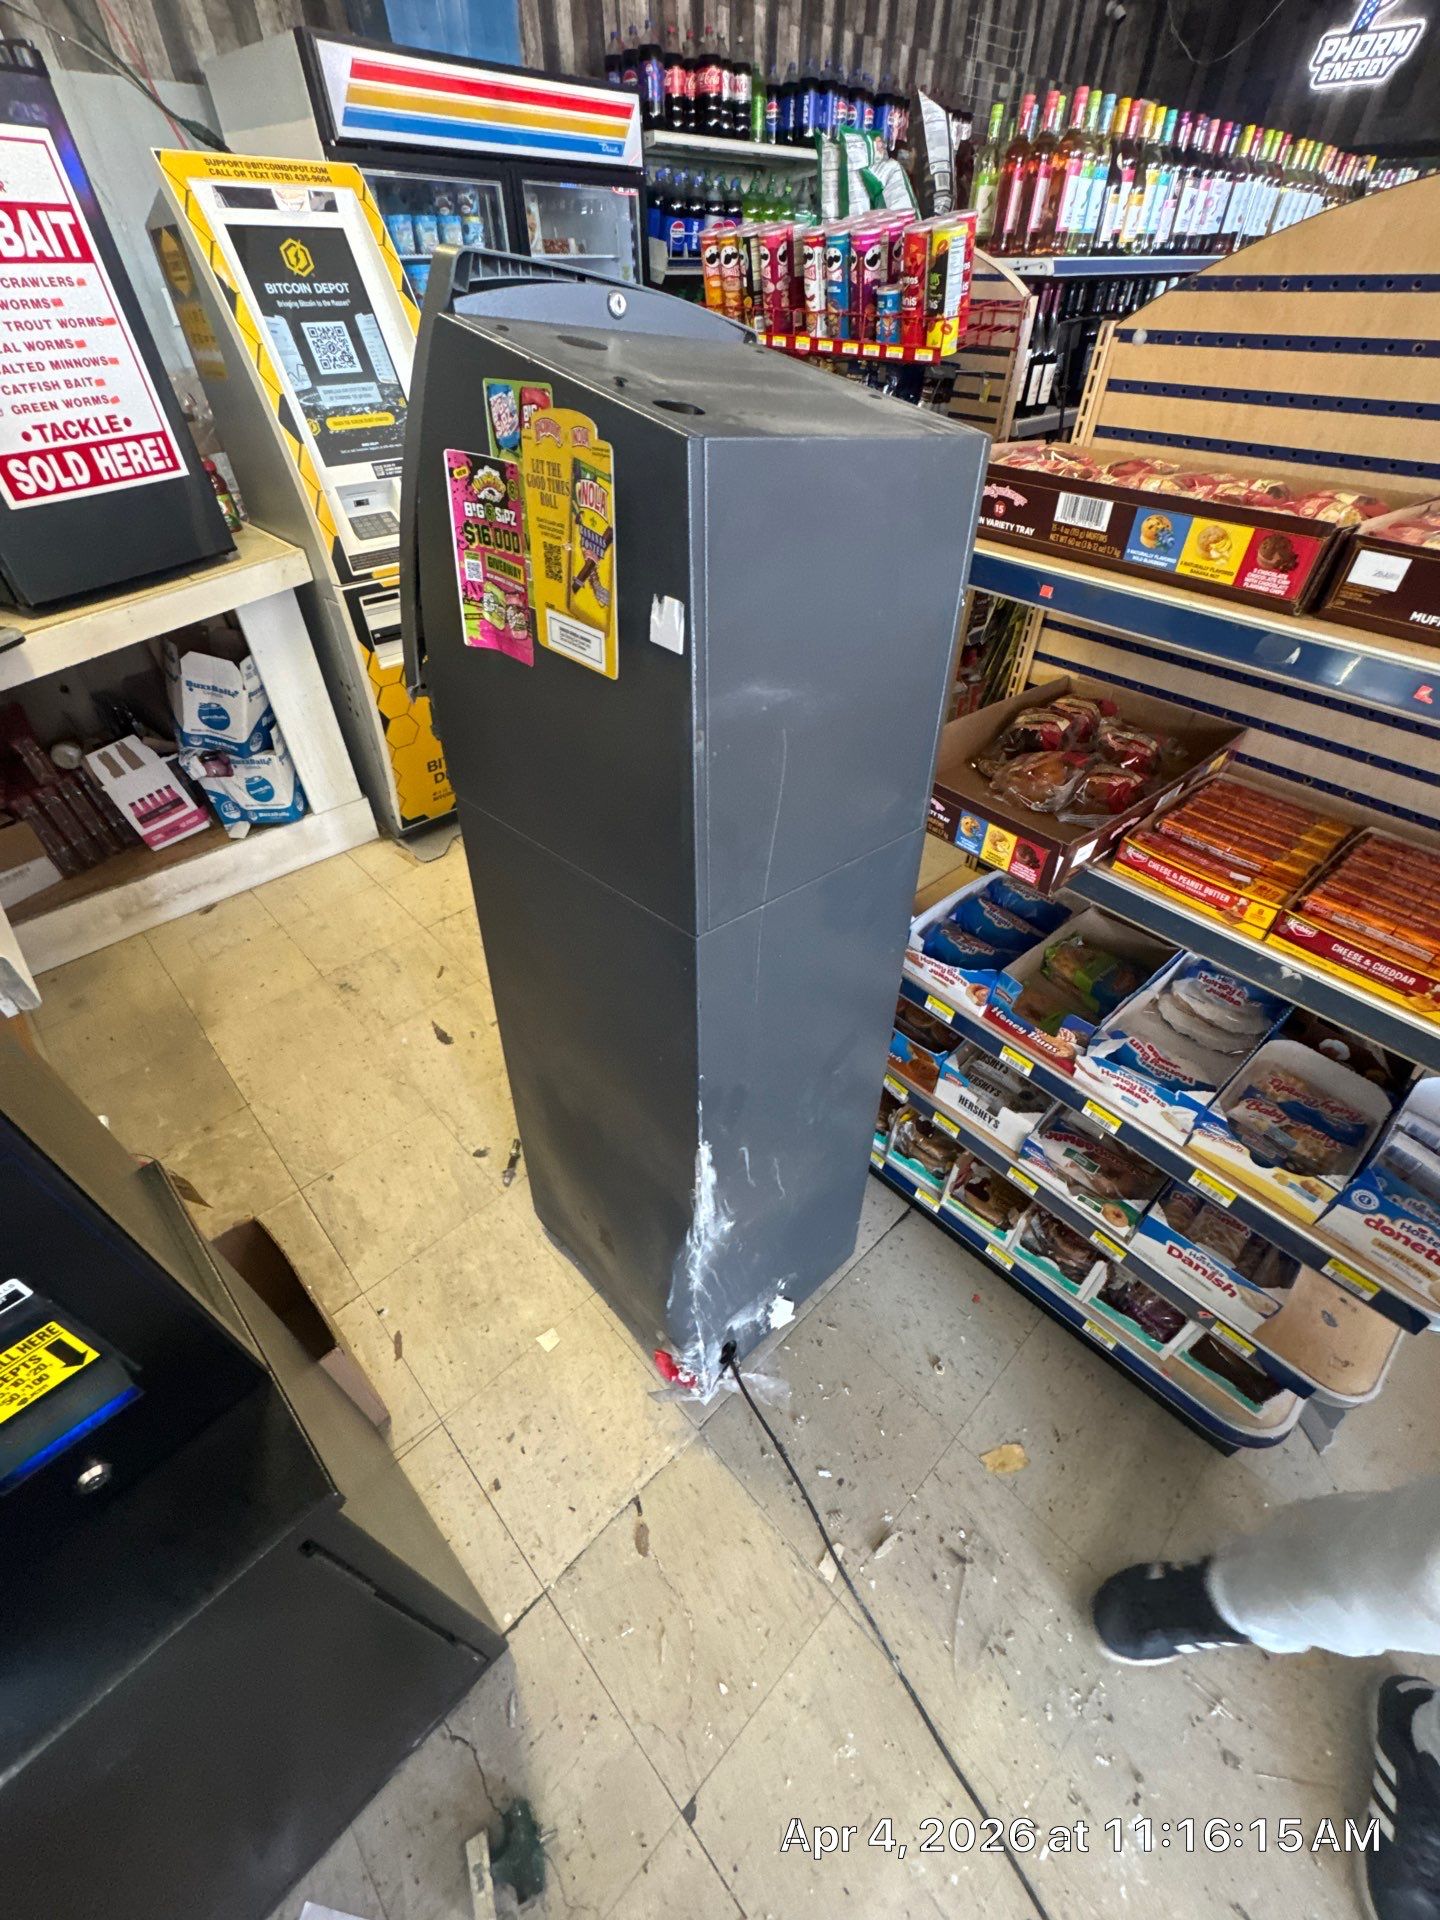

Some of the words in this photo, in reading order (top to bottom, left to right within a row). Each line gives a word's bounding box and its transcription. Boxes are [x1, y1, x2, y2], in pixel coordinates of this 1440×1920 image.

[1315, 27, 1418, 64] PHORM
[1318, 56, 1396, 81] ENERGY
[203, 158, 329, 175] SUPPORT@BITCOINDEPOT.COM
[209, 168, 232, 178] CALL
[234, 169, 247, 178] OR
[249, 170, 270, 180] TEXT
[271, 172, 293, 181] (678)
[294, 173, 333, 184] 435-9604
[0, 209, 83, 258] BAIT
[1, 276, 75, 289] CRAWLERS
[264, 282, 311, 295] BITCOIN
[313, 281, 350, 294] DEPOT
[0, 298, 51, 311] WORMS
[3, 318, 52, 333] TROUT
[56, 316, 105, 330] WORMS
[23, 338, 75, 352] WORMS
[50, 356, 109, 371] MINNOWS
[2, 379, 61, 396] CATFISH
[63, 376, 94, 390] BAIT
[11, 402, 60, 416] GREEN
[62, 394, 110, 409] WORMS
[32, 414, 123, 443] TACKLE
[7, 450, 91, 495] SOLD
[90, 436, 174, 480] HERE!
[531, 459, 545, 474] LET
[546, 461, 561, 478] THE
[526, 473, 546, 491] GOOD
[547, 477, 570, 496] TIMES
[540, 492, 558, 509] ROLL
[995, 503, 1004, 514] 15
[986, 517, 1015, 532] VARIETY
[1016, 524, 1036, 537] TRAY
[1148, 860, 1172, 877] CHEESE
[1172, 871, 1178, 881] &
[1177, 875, 1204, 892] PEANUT
[1203, 885, 1231, 903] BUTTER
[1287, 918, 1314, 937] Keebler
[920, 956, 949, 974] Honey
[947, 967, 969, 988] Buns
[1331, 943, 1363, 963] CHEESE
[1363, 958, 1371, 966] &
[1372, 962, 1417, 986] CHEDDAR
[1198, 972, 1237, 995] Honey
[991, 1006, 1027, 1035] Honey
[1028, 1031, 1061, 1055] Buns
[1101, 1068, 1138, 1091] Honey
[1137, 1086, 1168, 1109] Buns
[958, 1095, 1001, 1130] HERSHEY'S
[1246, 1100, 1288, 1124] Baby
[1165, 1244, 1239, 1298] Danish
[16, 1324, 60, 1354] HERE
